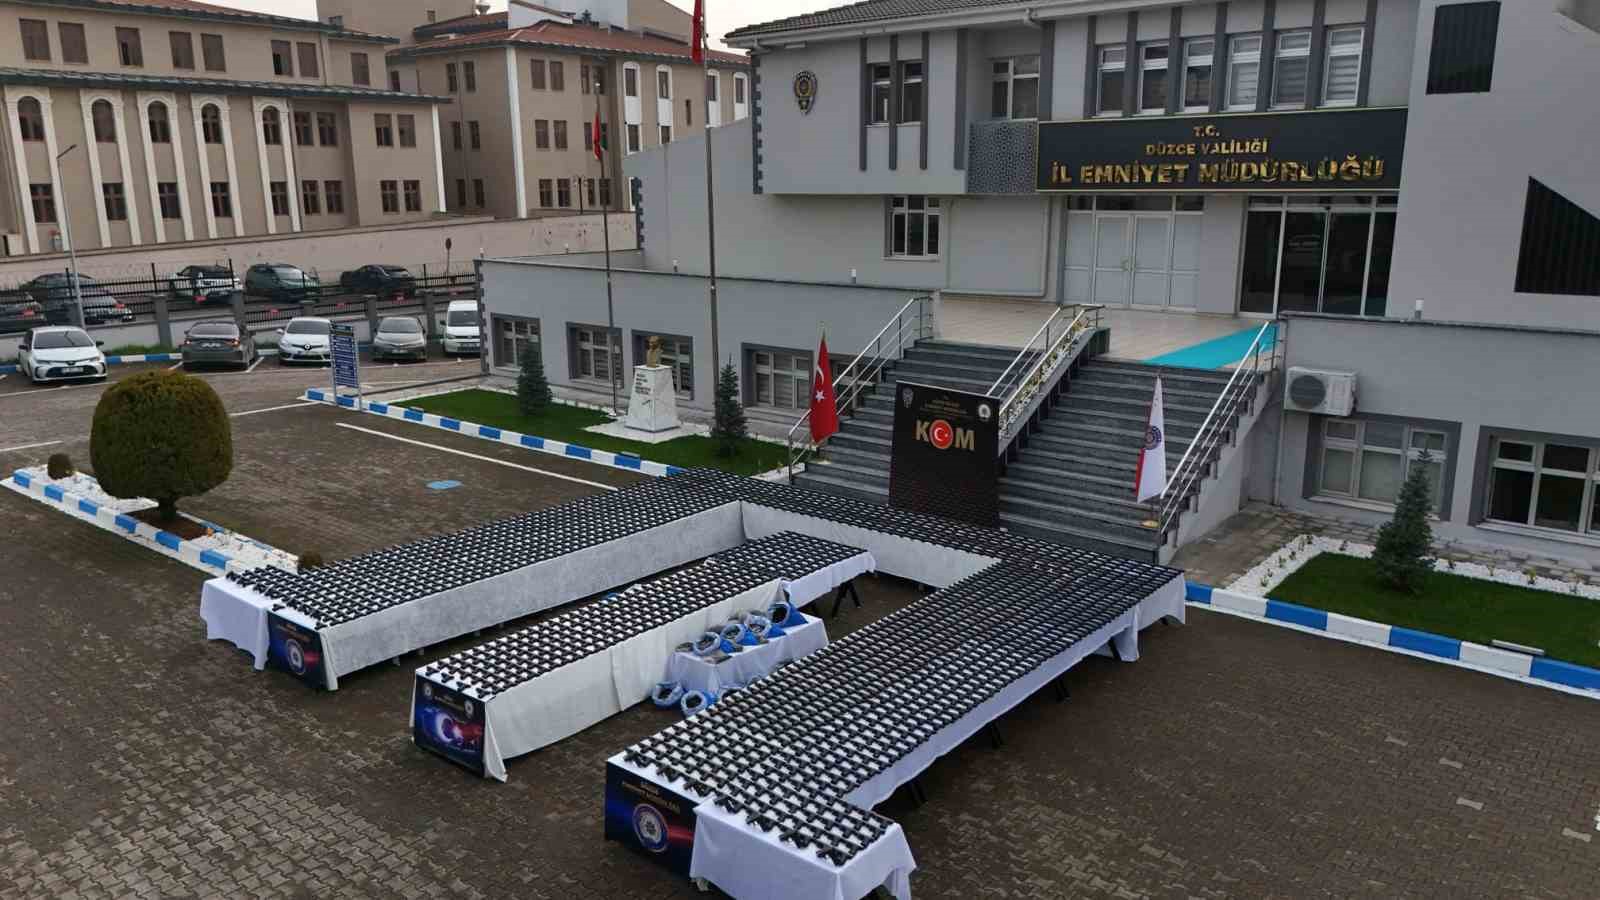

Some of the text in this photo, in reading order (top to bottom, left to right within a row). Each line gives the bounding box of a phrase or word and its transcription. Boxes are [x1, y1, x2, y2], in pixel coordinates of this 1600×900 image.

[1193, 125, 1220, 137] T.C.
[1146, 141, 1196, 155] DÜZCE
[1052, 153, 1385, 184] İL EMNİYET MÜDÜRLÜĞÜ
